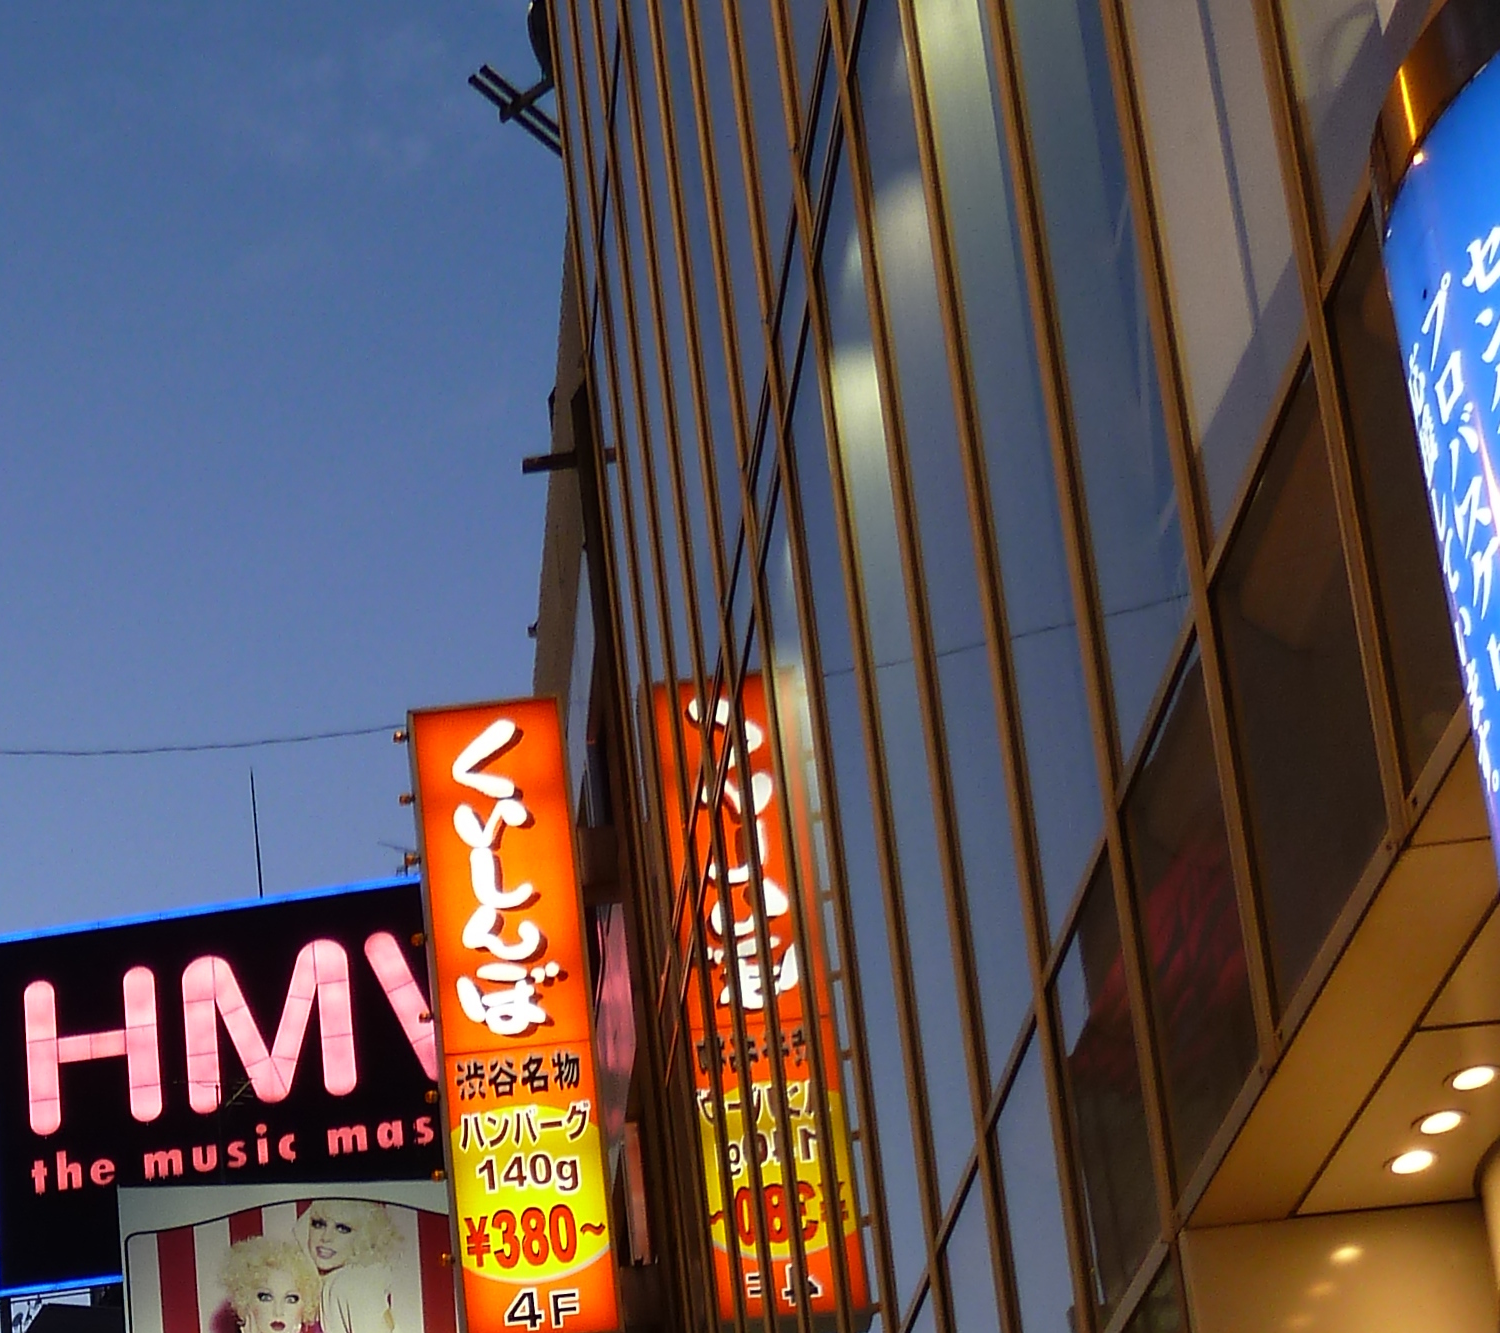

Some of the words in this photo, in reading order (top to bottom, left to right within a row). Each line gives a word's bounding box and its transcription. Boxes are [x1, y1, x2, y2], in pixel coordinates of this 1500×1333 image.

[454, 1051, 582, 1102] 渋谷名物
[458, 1100, 590, 1153] ハンバーグ
[31, 1150, 116, 1195] the
[143, 1122, 298, 1184] music
[476, 1151, 583, 1195] 140g
[502, 1289, 583, 1332] 4F
